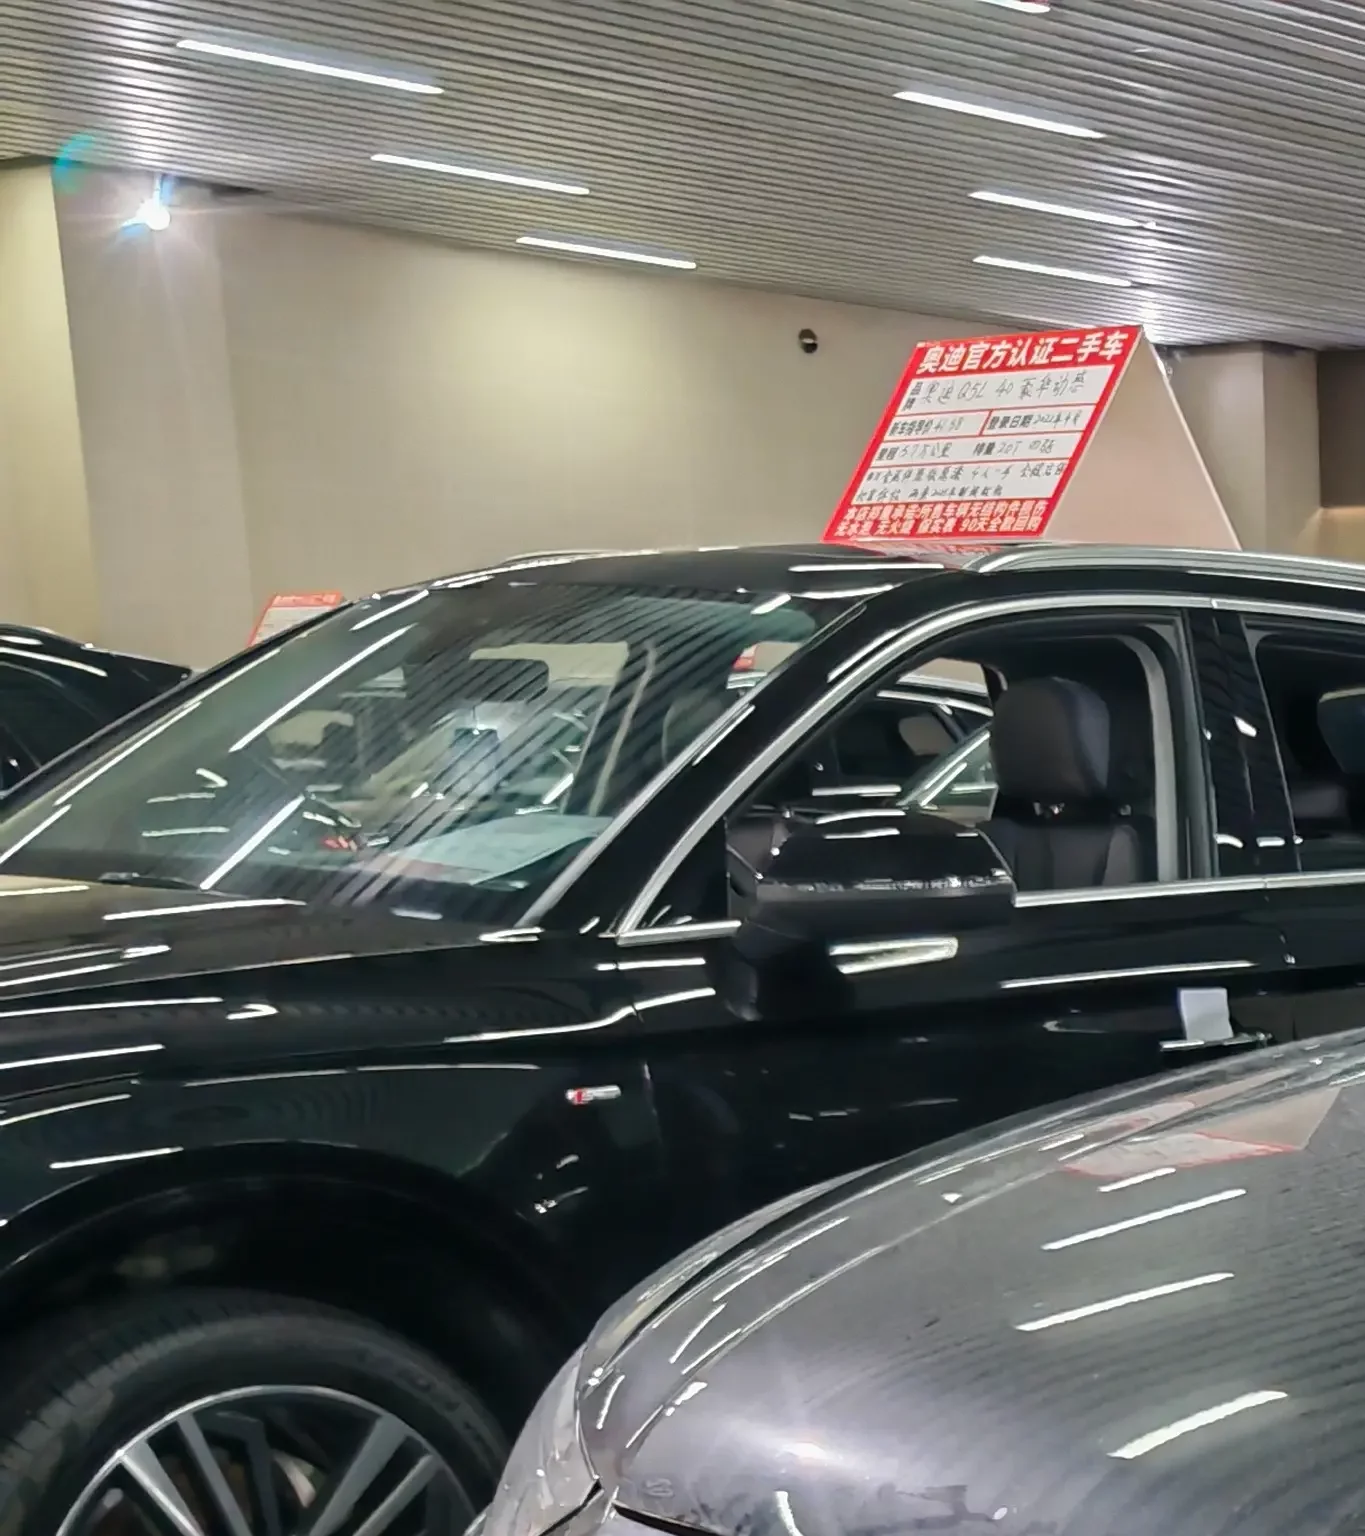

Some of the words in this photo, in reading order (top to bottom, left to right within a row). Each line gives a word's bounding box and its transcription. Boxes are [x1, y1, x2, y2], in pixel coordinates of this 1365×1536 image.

[915, 332, 1128, 375] 奥迪官方认证二手车
